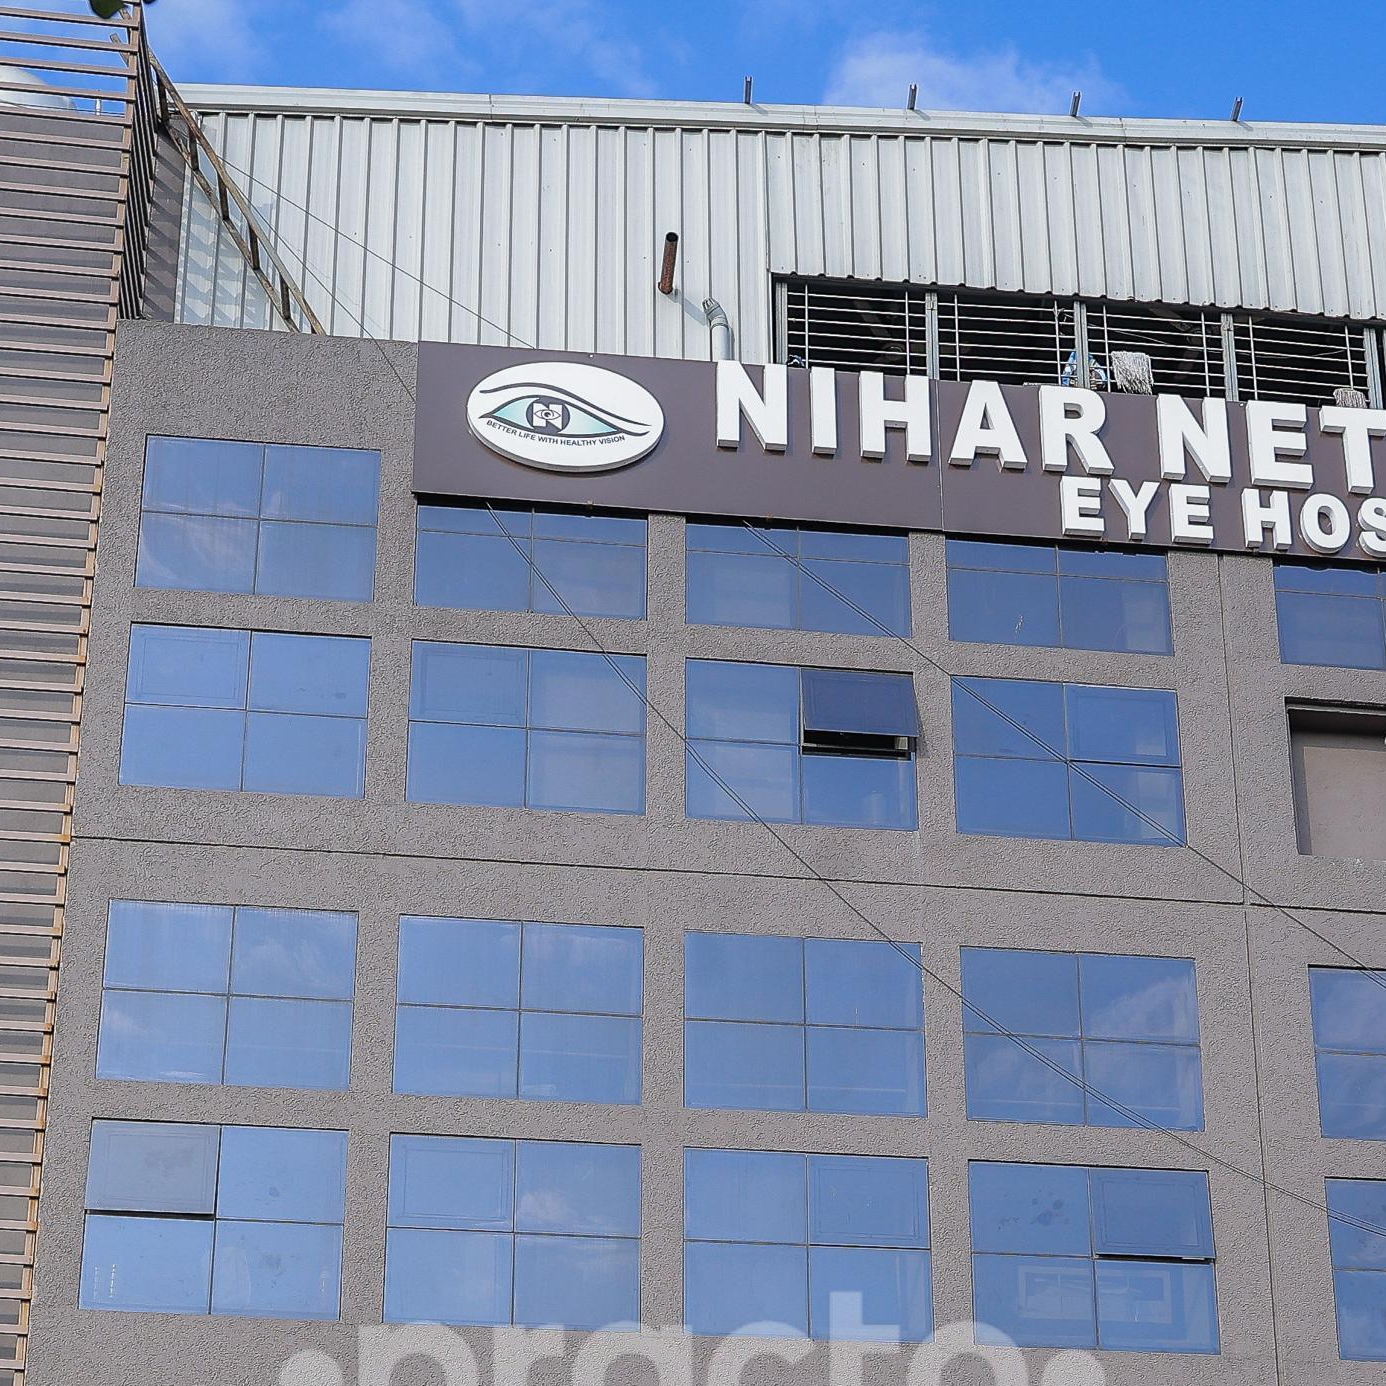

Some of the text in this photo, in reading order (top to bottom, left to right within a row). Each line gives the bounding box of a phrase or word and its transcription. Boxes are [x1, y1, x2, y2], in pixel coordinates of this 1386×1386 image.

[486, 419, 626, 447] BETTER LIFE WITH HEALTHY VISION
[714, 361, 1114, 476] NIHAR
[1059, 474, 1214, 546] EYE
